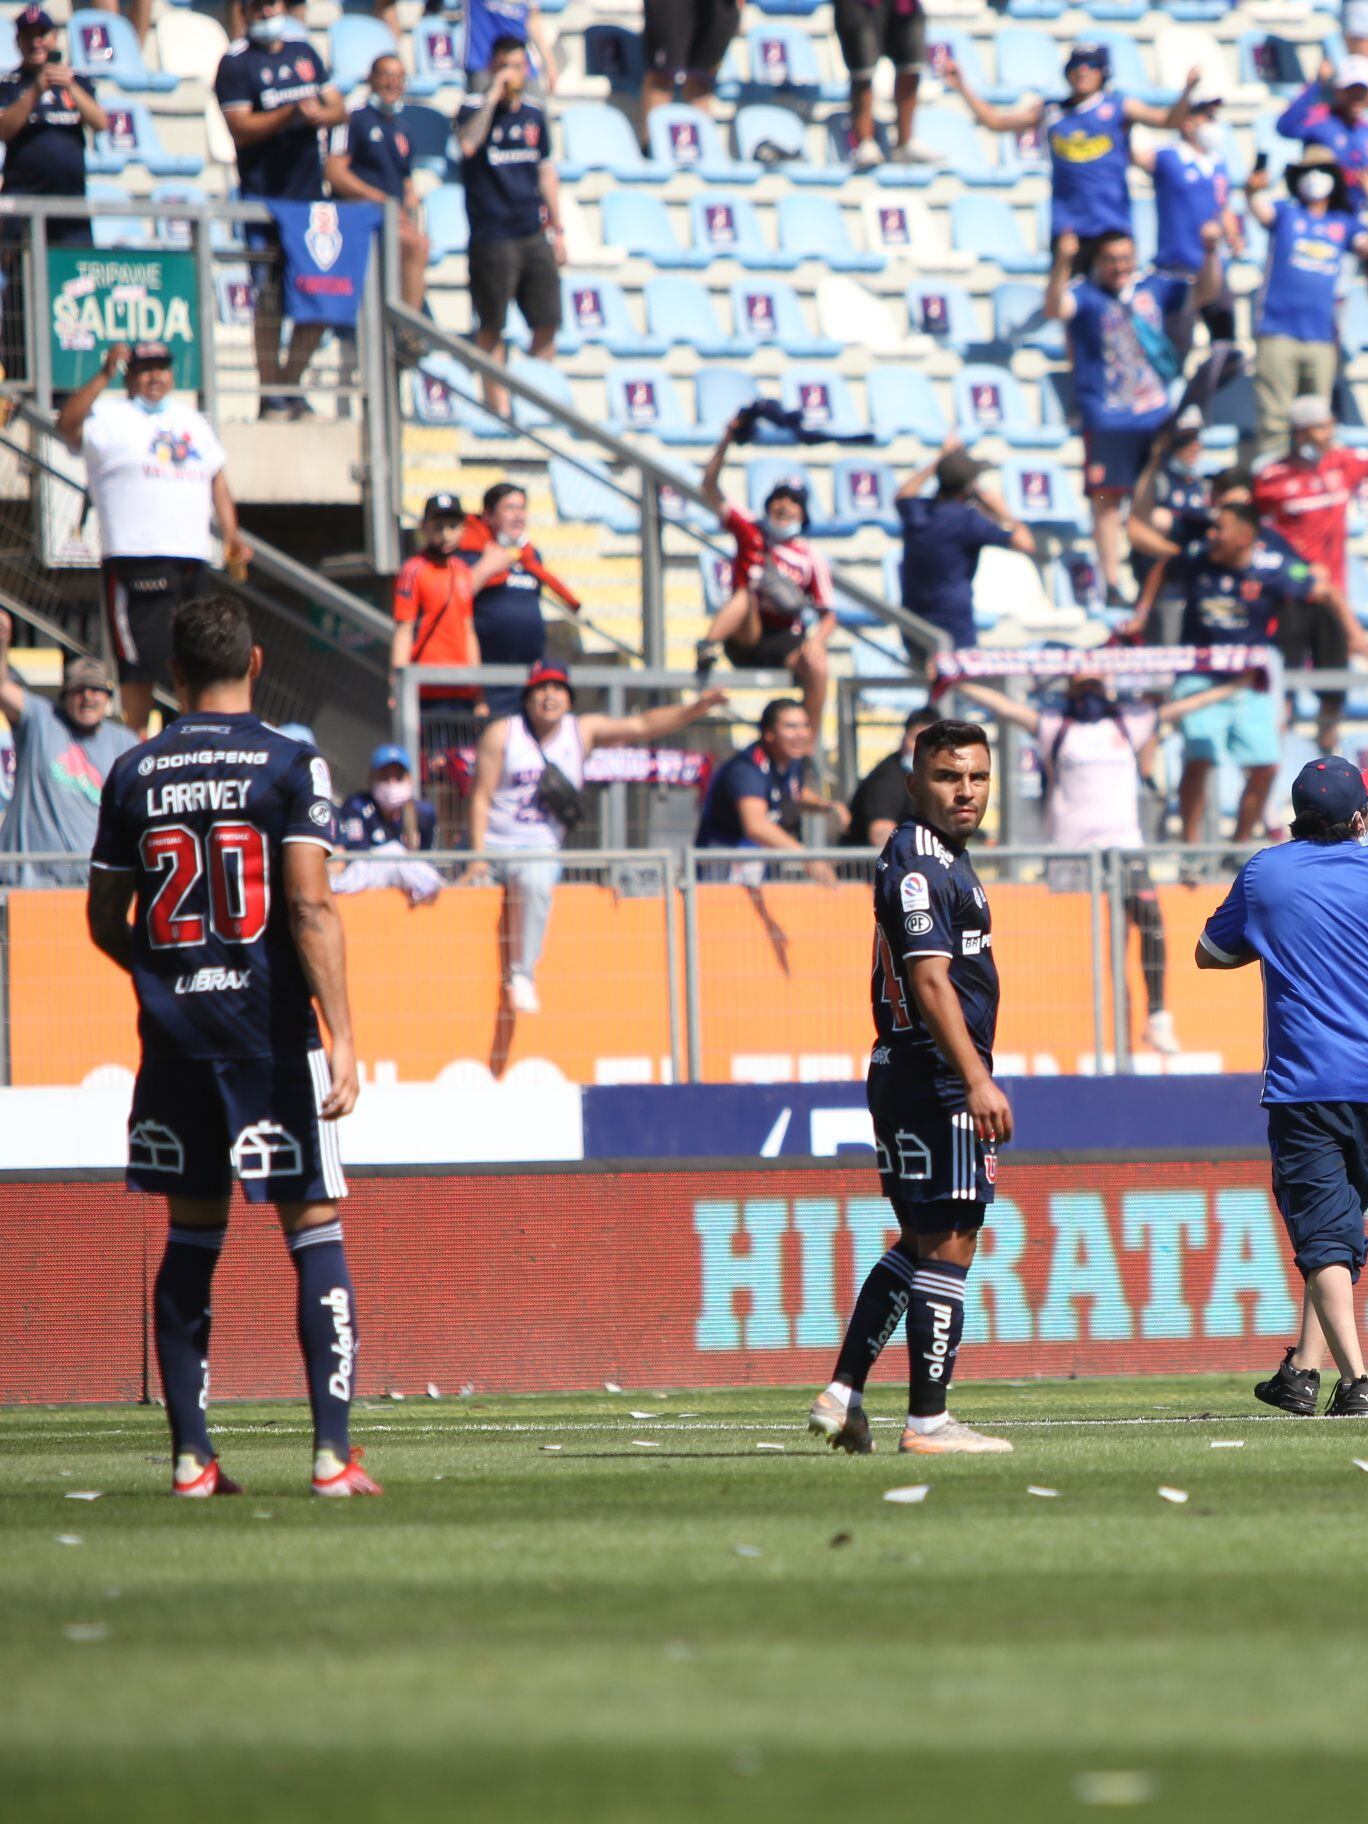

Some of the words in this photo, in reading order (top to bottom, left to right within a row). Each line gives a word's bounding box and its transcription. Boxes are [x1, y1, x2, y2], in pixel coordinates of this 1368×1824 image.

[53, 296, 193, 342] SALIDA
[156, 751, 269, 770] DONGFENG
[138, 820, 270, 949] 20
[911, 917, 924, 929] PF
[320, 1286, 352, 1402] Dolorub
[866, 1288, 910, 1358] lorub
[923, 1301, 952, 1382] oloru
